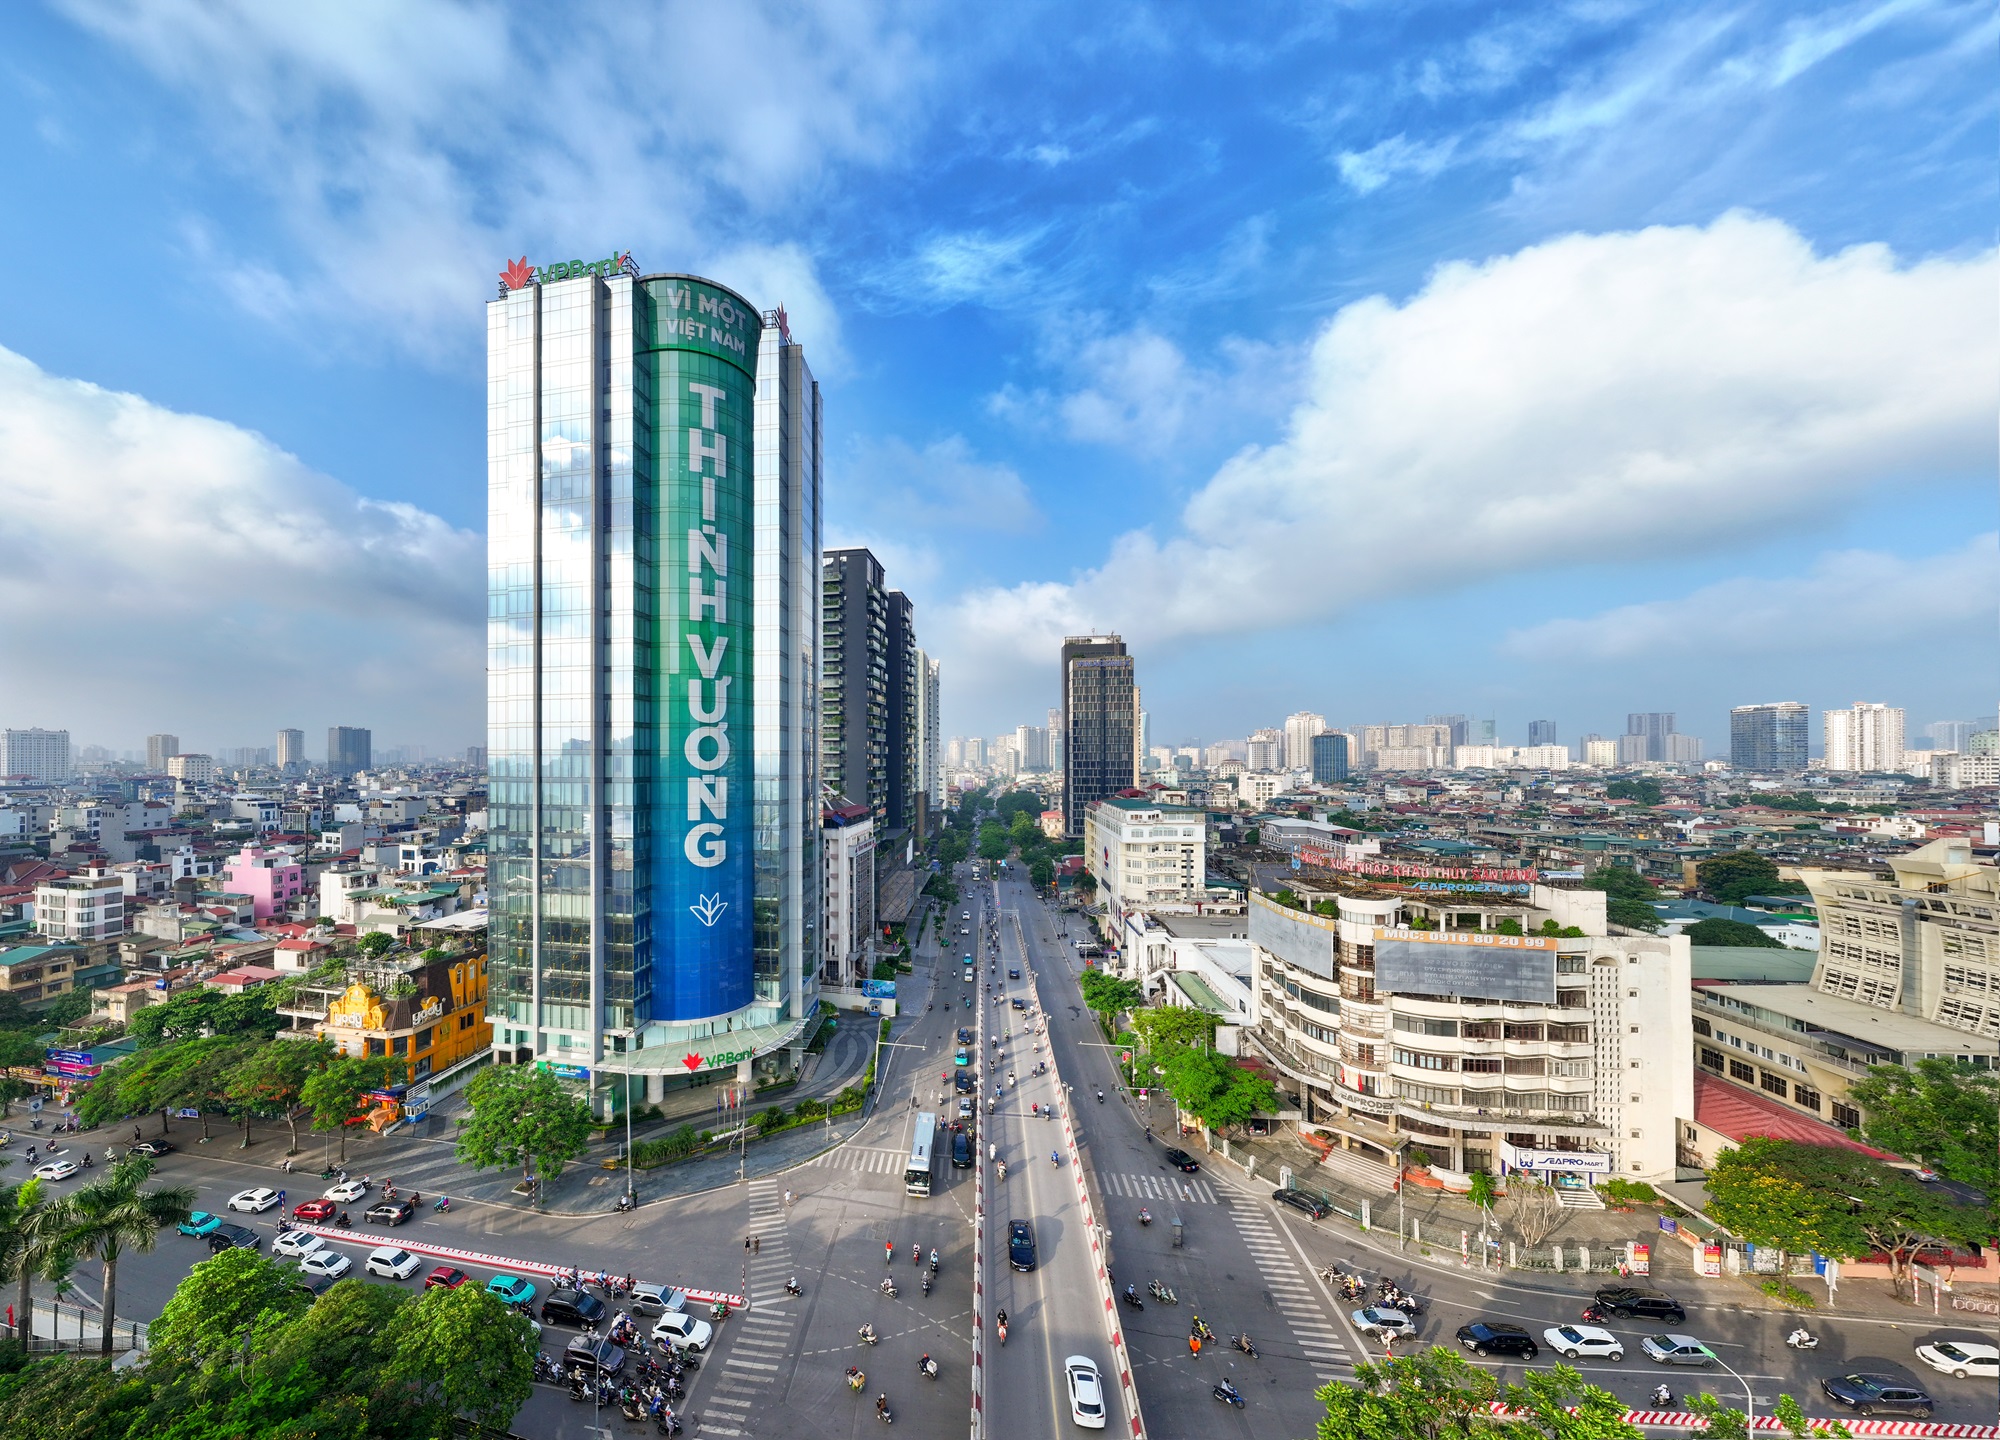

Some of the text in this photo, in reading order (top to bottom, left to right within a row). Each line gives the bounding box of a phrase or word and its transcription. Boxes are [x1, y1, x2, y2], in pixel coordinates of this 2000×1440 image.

[537, 251, 627, 285] VPBank
[667, 284, 746, 330] VÌ MỘT
[666, 317, 745, 356] VIỆT NAM
[1356, 861, 1389, 877] NHẬP
[1283, 907, 1294, 918] 80
[1297, 912, 1310, 922] 20
[1313, 916, 1326, 927] 99
[1384, 929, 1545, 947] MQC: 0916 80 20 99
[335, 1012, 363, 1028] yody
[413, 1003, 443, 1026] yody
[706, 1046, 757, 1068] VPBank
[1538, 1157, 1584, 1166] SEAPRO
